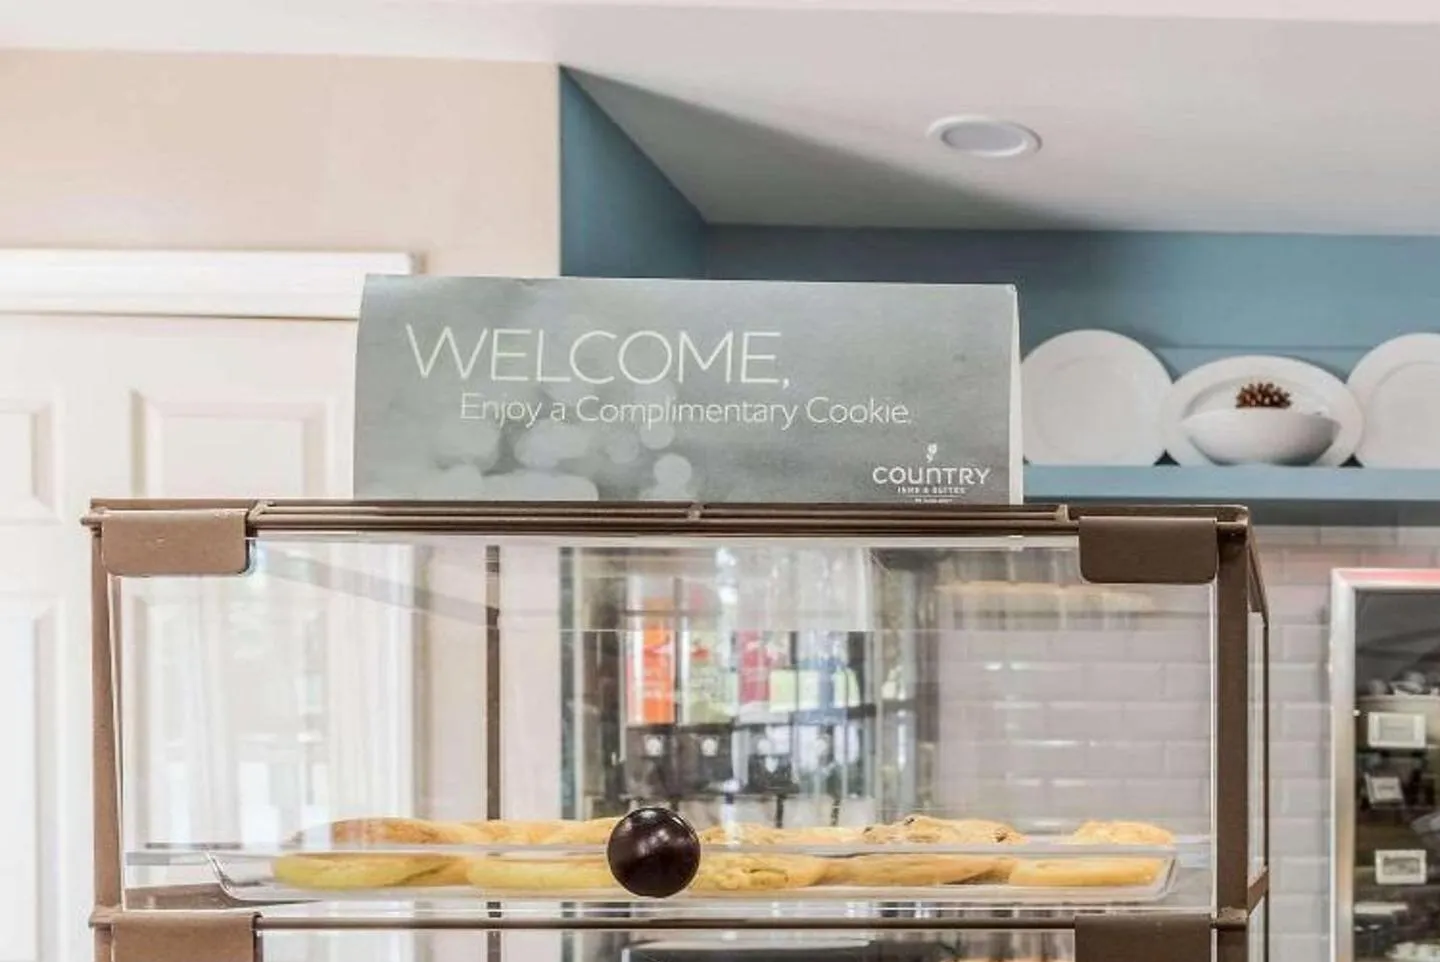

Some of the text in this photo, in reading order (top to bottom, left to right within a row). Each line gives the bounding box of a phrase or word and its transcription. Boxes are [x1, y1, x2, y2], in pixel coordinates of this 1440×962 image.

[405, 322, 790, 390] WELCOME,
[460, 392, 543, 428] Enjoy
[550, 401, 566, 421] a
[576, 394, 799, 431] Complimentary
[872, 466, 991, 485] COUNTRY
